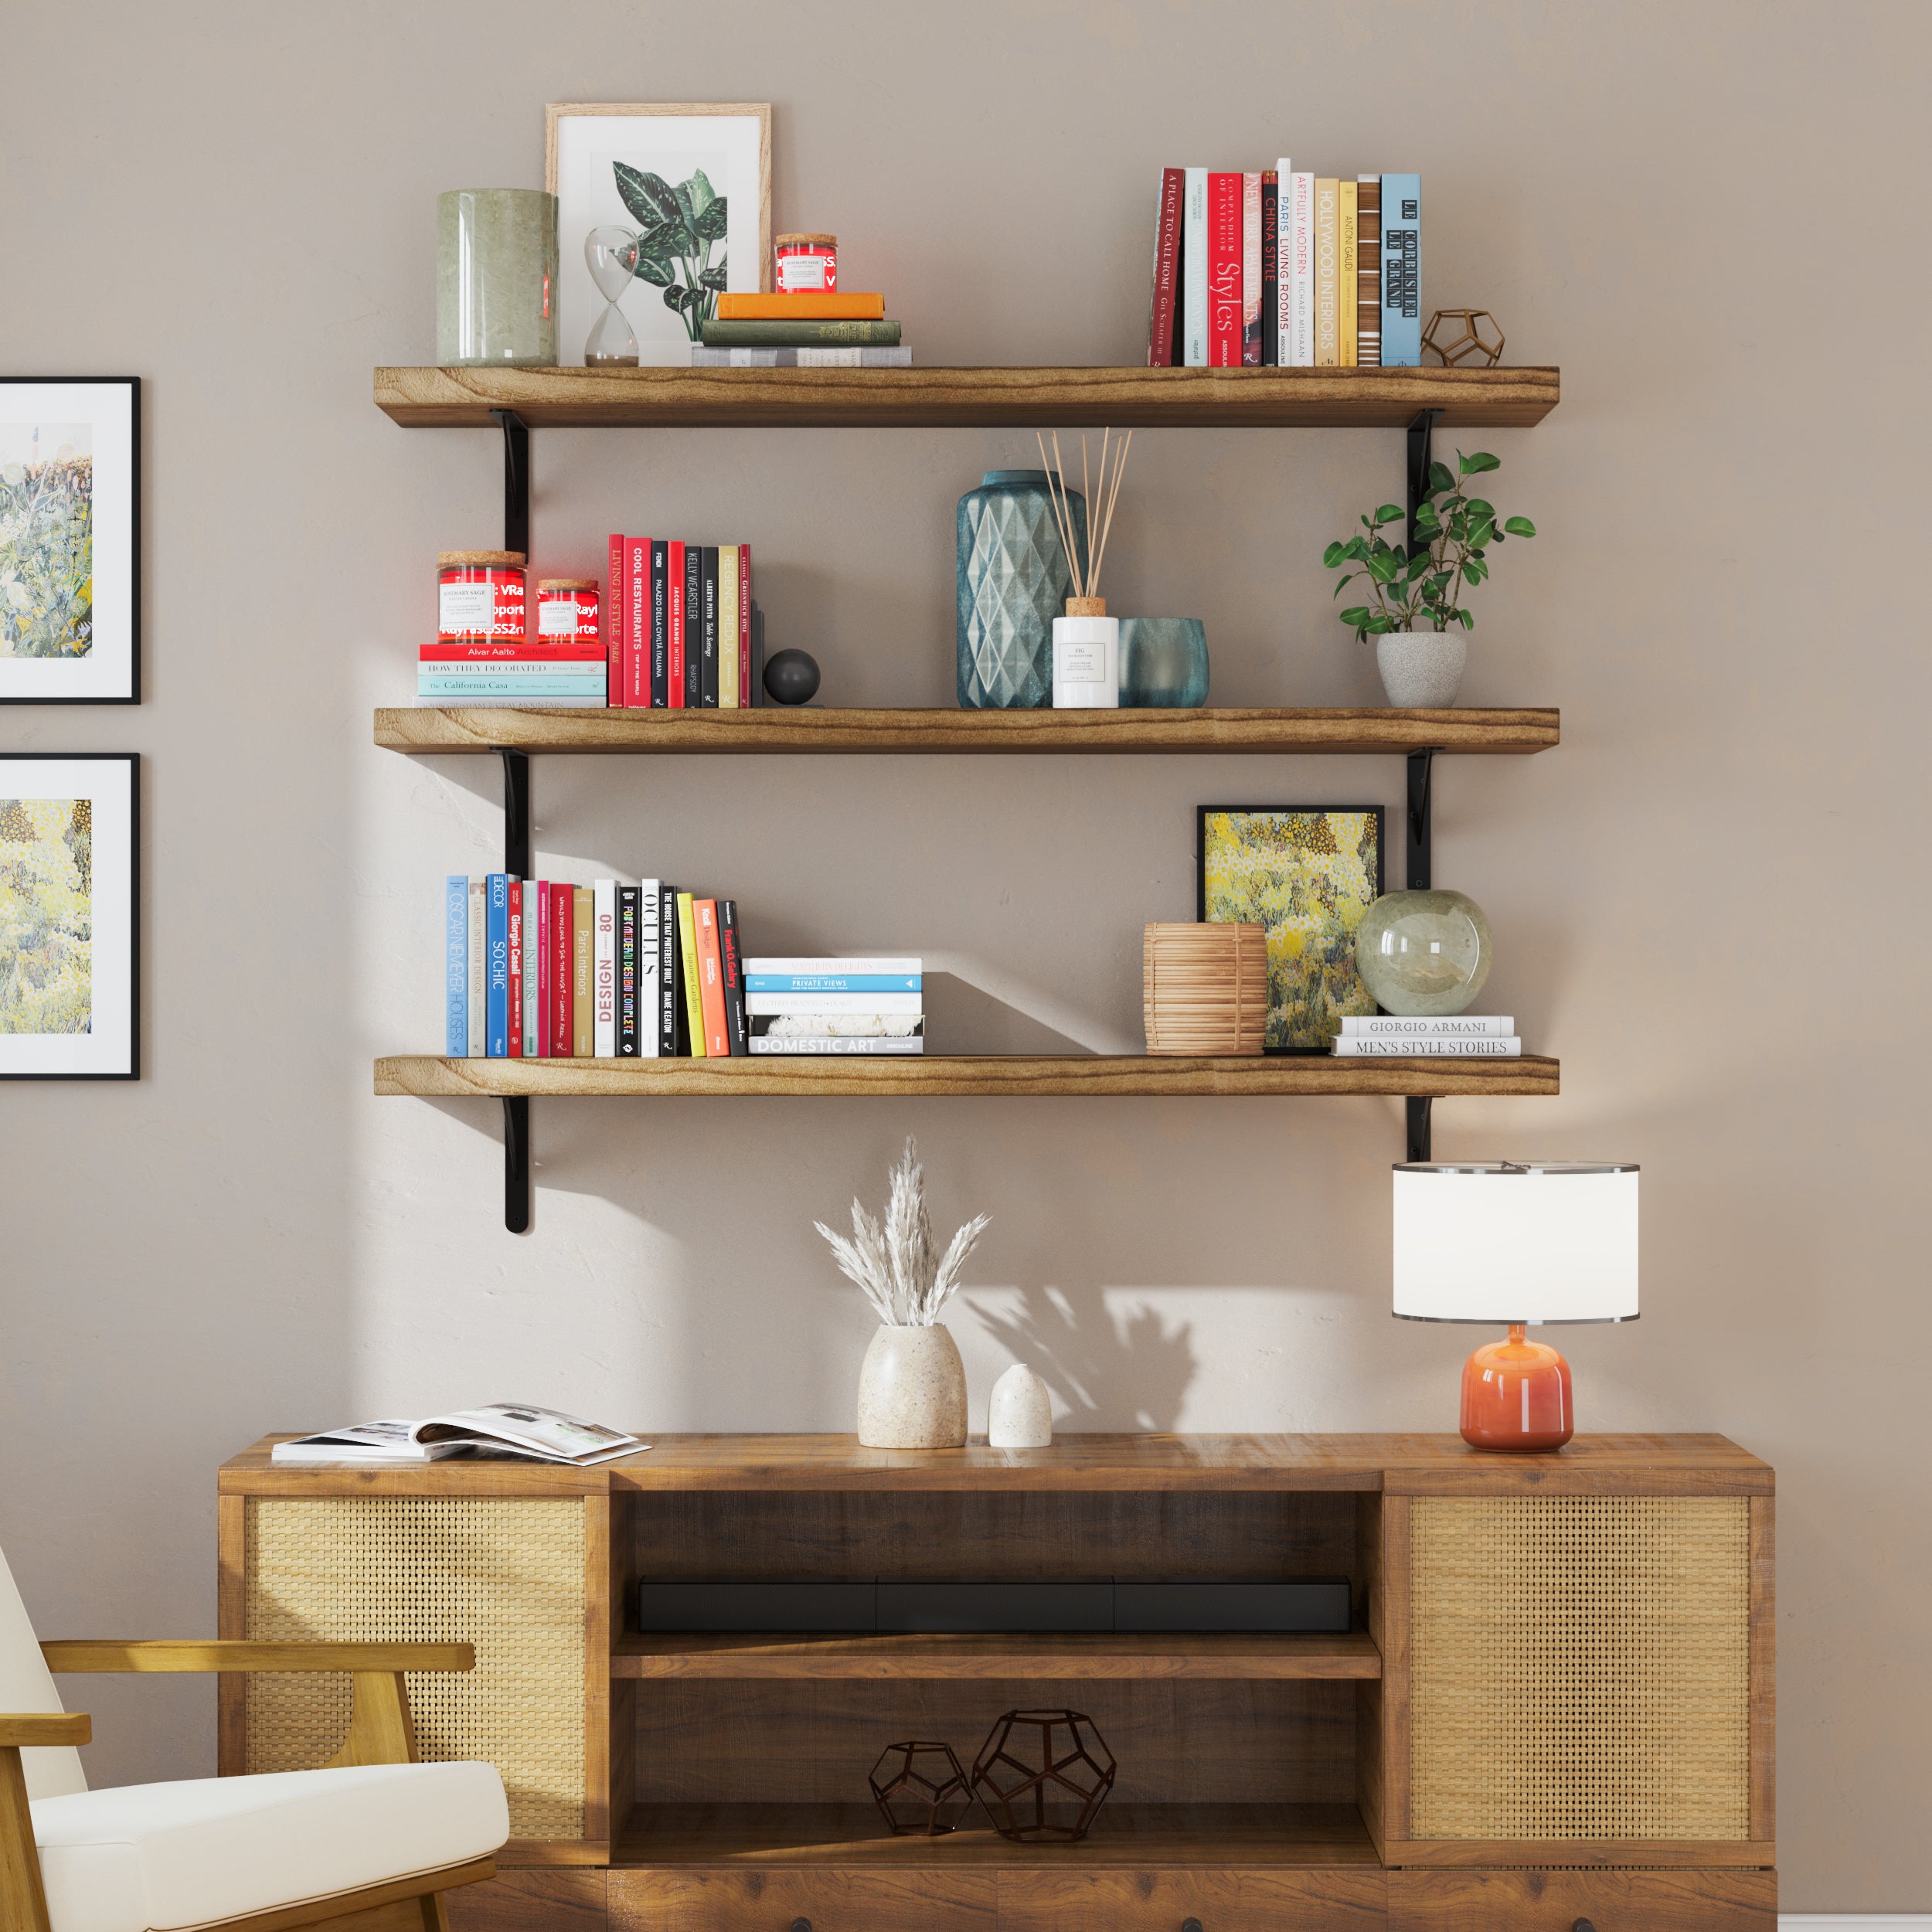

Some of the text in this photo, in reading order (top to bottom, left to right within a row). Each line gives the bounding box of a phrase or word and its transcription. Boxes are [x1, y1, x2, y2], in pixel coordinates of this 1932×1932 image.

[1167, 184, 1177, 214] PLACE
[1219, 179, 1226, 192] OF
[1297, 176, 1308, 223] ARTFULLY
[1165, 217, 1175, 232] TO
[1279, 196, 1289, 232] PARIS
[1403, 200, 1417, 219] LE
[1164, 233, 1173, 258] CALL
[1265, 197, 1277, 281] CHINA STYLE
[1344, 216, 1354, 245] ANTONI
[1244, 181, 1258, 320] NEW YORK APARTMENTS
[1279, 238, 1289, 279] LIVING
[1297, 226, 1308, 274] MODERN
[1344, 247, 1355, 271] GAUDÍ
[1162, 261, 1171, 291] HOME
[1319, 191, 1335, 349] HOLLYWOOD INTERIORS
[1387, 230, 1403, 308] LE GRAND
[1403, 230, 1417, 318] CORBUSIER
[1209, 262, 1243, 331] Styles
[1279, 284, 1289, 330] ROOMS
[633, 547, 642, 575] COOL
[687, 553, 698, 574] KELLY
[611, 549, 621, 664] LIVING IN STYLE PARIS
[633, 577, 642, 651] RESTAURANTS
[687, 576, 698, 620] WEARSTLER
[724, 556, 735, 655] REGENCY REDUX
[517, 648, 558, 656] Architect
[655, 627, 664, 650] CIVILTÀ
[704, 636, 713, 658] Settings
[444, 681, 486, 689] California
[488, 681, 509, 689] Casa
[473, 896, 482, 927] CLASSIC
[493, 879, 505, 908] DECOR
[449, 893, 464, 934] OSCAR
[509, 914, 521, 947] Giorgio
[599, 913, 612, 932] 80
[701, 907, 712, 927] Knoll
[473, 929, 482, 964] INTERIOR
[623, 906, 634, 960] POSTMODERN
[643, 893, 658, 975] OCULUS
[703, 927, 713, 949] Design
[449, 937, 464, 992] NIEMEYER
[492, 940, 505, 990] SO CHIC
[511, 948, 521, 975] Casali
[526, 949, 536, 1001] INTERIORS
[578, 930, 590, 995] Paris Interiors
[623, 961, 634, 992] DESIGN
[663, 892, 672, 1033] THE HOUSE THAT PINTEREST BUILT DIANE KEATON
[723, 929, 738, 988] Frank O. Gehry
[473, 966, 482, 995] DESIGN
[599, 959, 612, 1022] DESIGN
[686, 952, 700, 1014] Japanese Gardens
[450, 994, 464, 1040] HOUSES
[623, 993, 634, 1035] COMPLETE
[1369, 1022, 1486, 1032] GIORGIO ARMANI
[757, 1039, 839, 1053] DOMESTIC
[847, 1039, 877, 1053] ART
[1355, 1041, 1507, 1053] MEN'S STYLE STORIES
